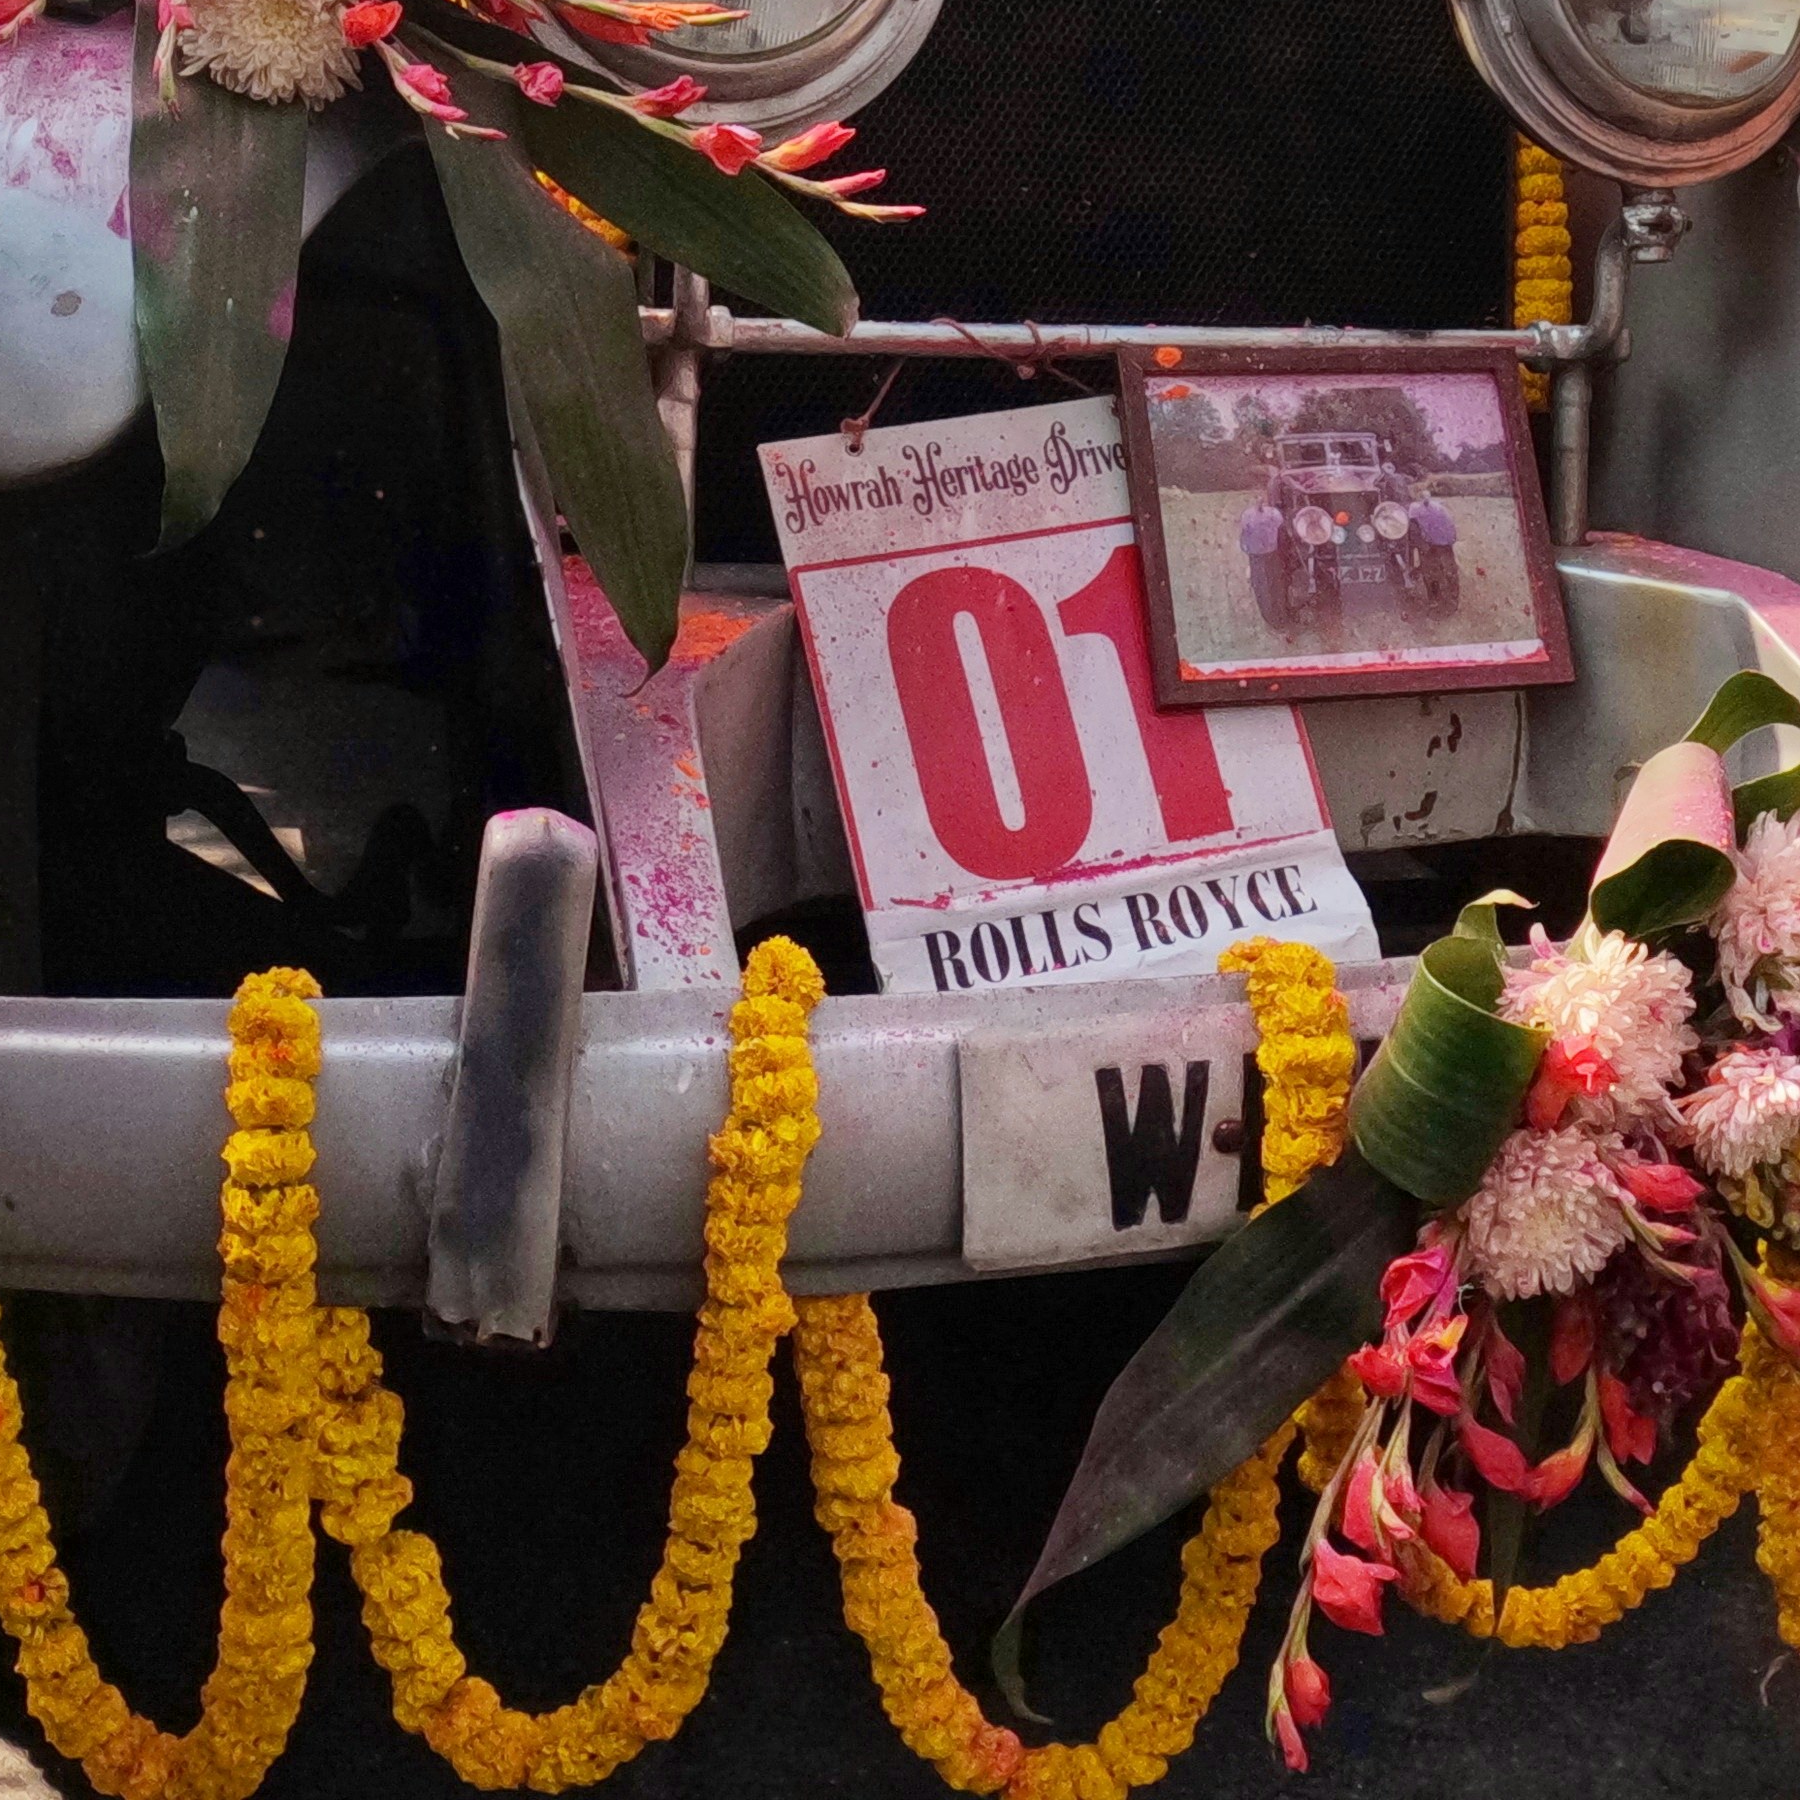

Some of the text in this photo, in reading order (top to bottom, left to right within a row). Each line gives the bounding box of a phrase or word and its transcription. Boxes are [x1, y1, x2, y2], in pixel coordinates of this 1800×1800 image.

[775, 420, 1129, 534] Howrah Heritage Drive
[887, 542, 1235, 881] 01
[920, 864, 1319, 993] ROLLS ROYCE
